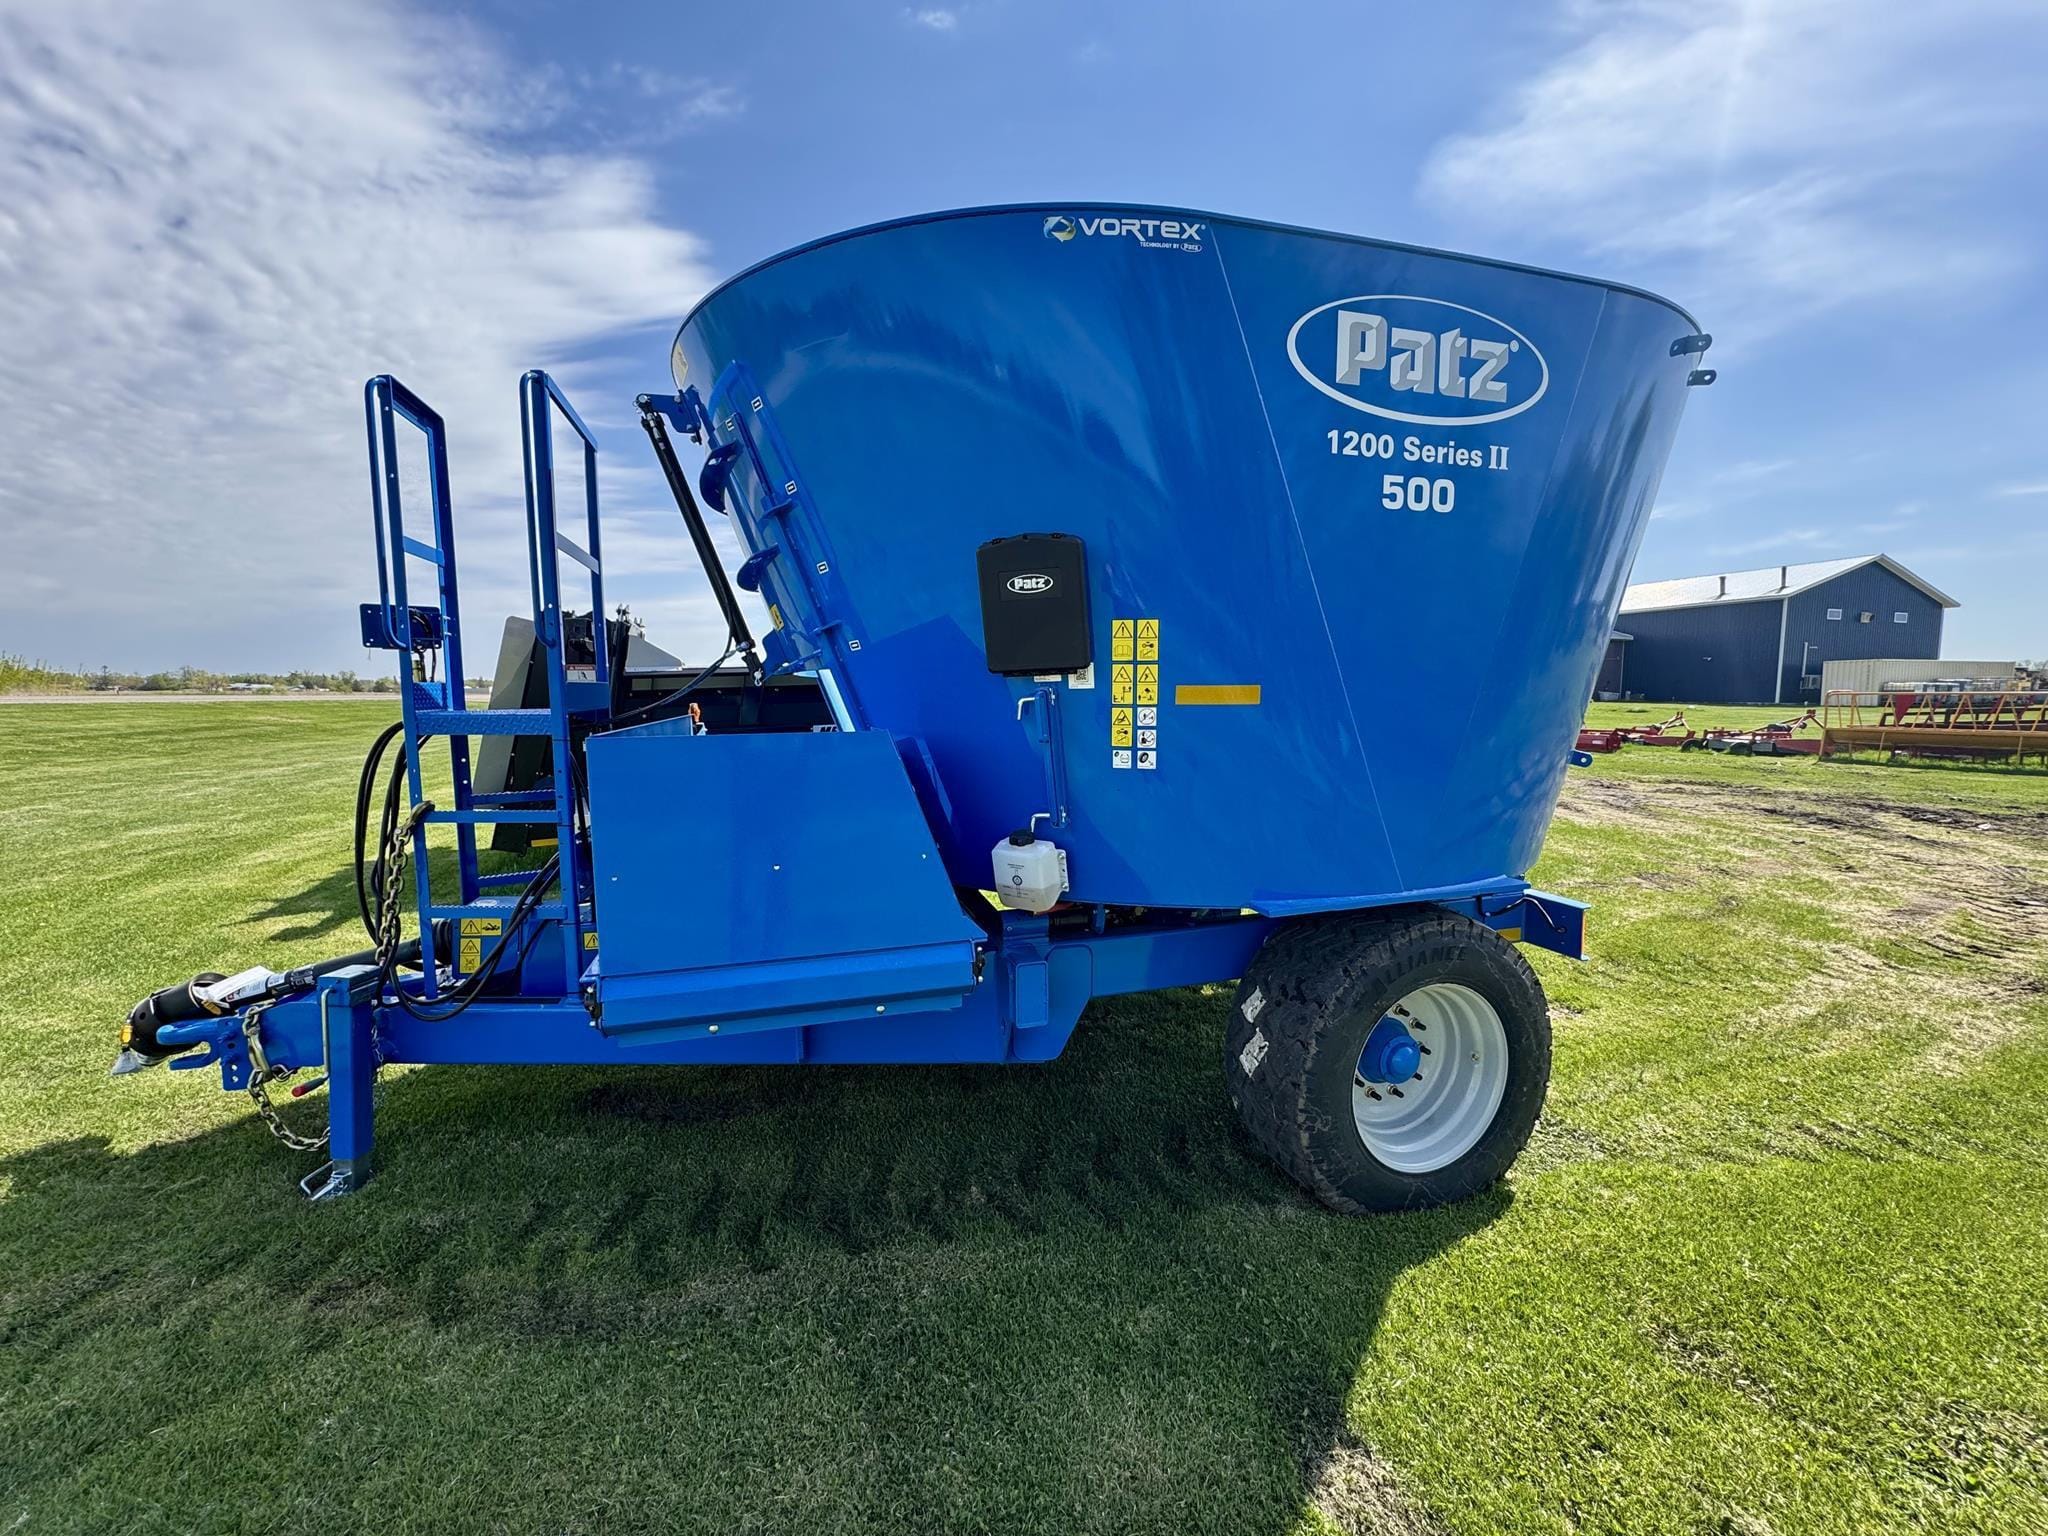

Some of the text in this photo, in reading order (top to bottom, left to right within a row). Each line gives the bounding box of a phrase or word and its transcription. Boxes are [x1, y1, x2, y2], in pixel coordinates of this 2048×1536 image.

[1335, 310, 1509, 403] Patz
[1327, 429, 1510, 470] 1200 Series II
[1381, 474, 1456, 513] 500
[1014, 577, 1046, 590] Patz
[1374, 945, 1467, 1002] ALLIANCE
